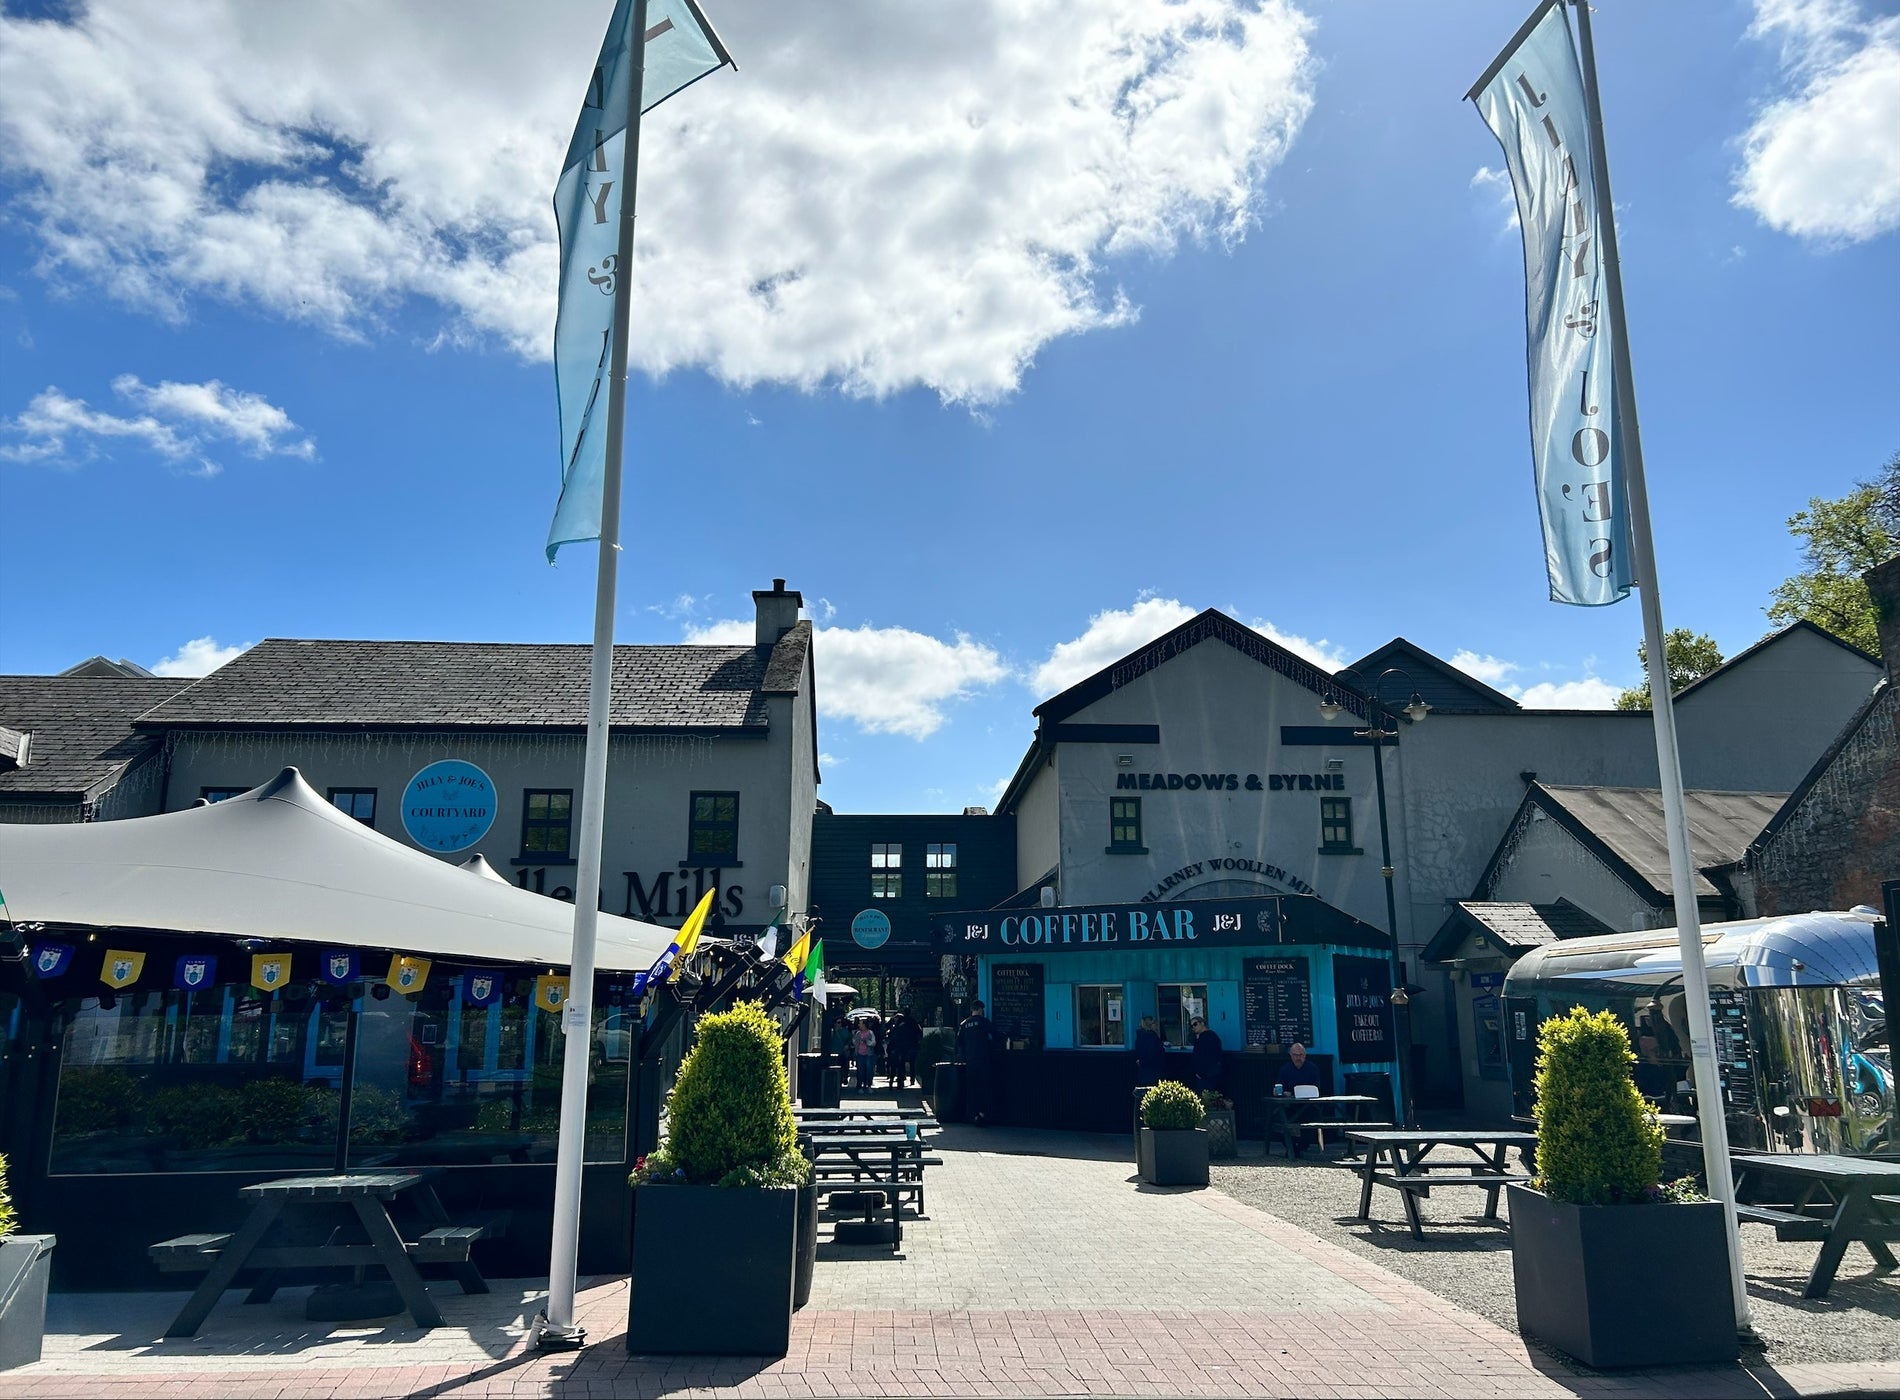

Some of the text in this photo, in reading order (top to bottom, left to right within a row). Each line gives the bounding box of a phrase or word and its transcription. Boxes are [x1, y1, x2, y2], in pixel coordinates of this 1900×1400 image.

[1117, 773, 1346, 792] MEADOWS & BYRNE
[411, 807, 487, 818] COURTYARD
[1207, 858, 1287, 881] WOOLLEN
[620, 867, 744, 918] Mills
[964, 909, 1242, 946] J&J COFFEE BAR J&J
